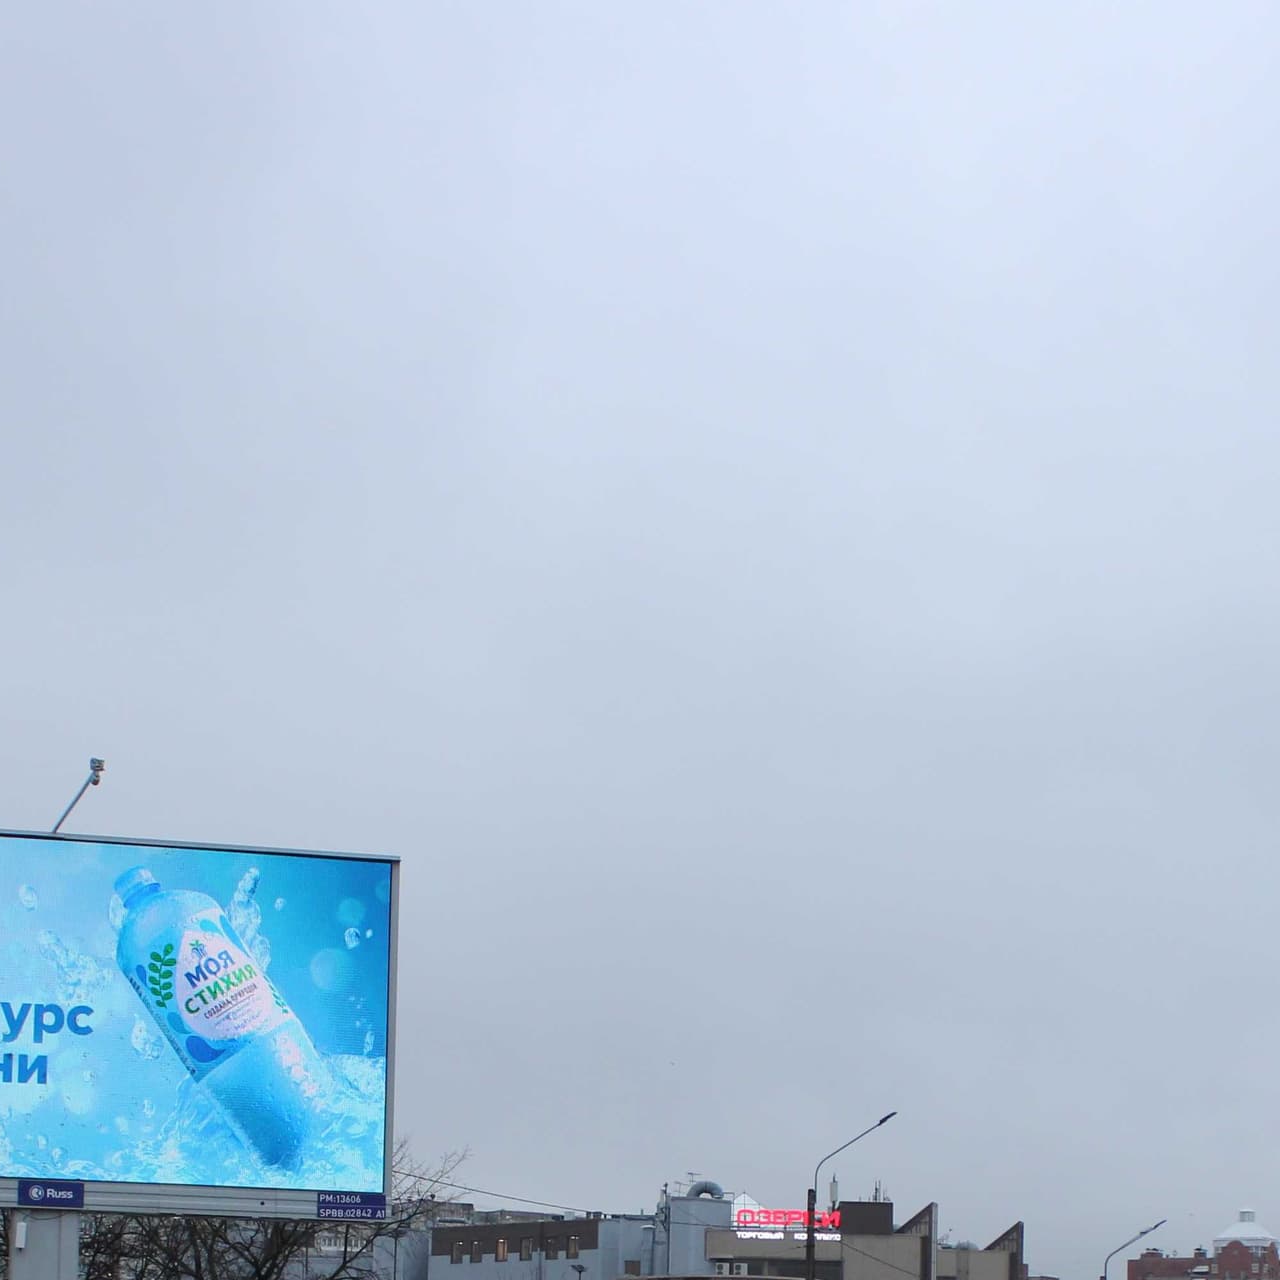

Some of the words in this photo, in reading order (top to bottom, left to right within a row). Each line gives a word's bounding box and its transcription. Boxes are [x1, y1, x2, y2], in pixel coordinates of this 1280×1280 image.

[184, 949, 236, 989] МОЯ
[184, 964, 258, 1015] СТИХИЯ
[46, 1188, 74, 1199] Russ
[736, 1231, 784, 1240] ТОРГОВЫЙ
[794, 1232, 841, 1241] КОПЛЕКС
